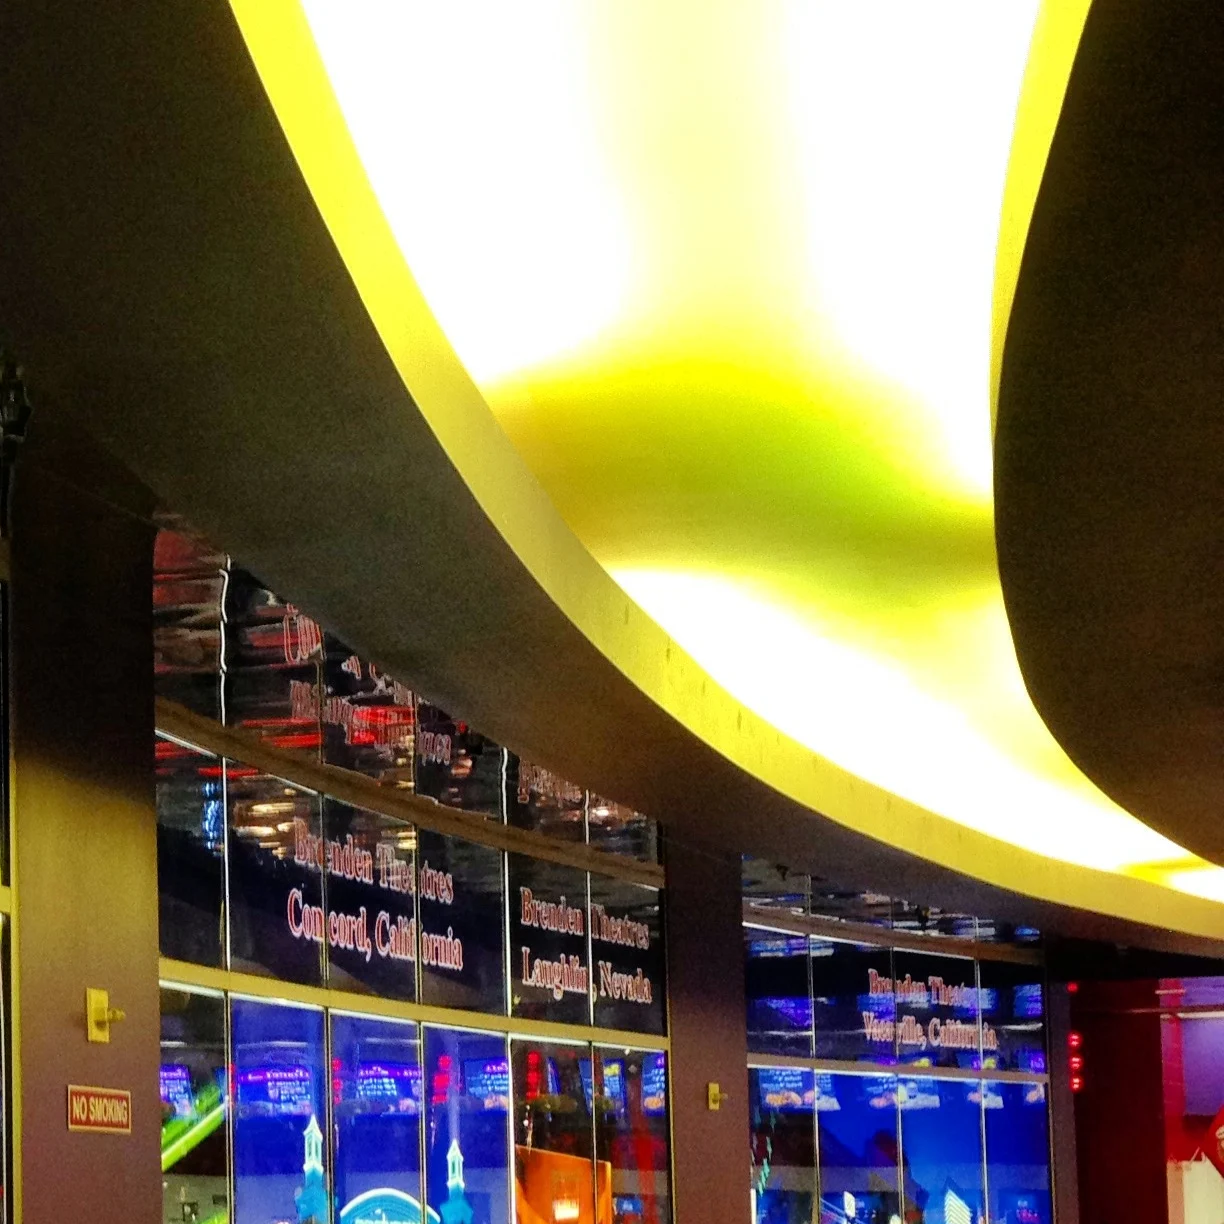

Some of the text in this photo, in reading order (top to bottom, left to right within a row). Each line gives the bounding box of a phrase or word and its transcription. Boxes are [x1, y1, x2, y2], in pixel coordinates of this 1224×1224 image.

[293, 816, 454, 904] Brenden Theatres
[287, 888, 464, 972] Concord, California
[520, 886, 650, 950] Brenden Theatres
[598, 960, 653, 1004] Nevada
[72, 1095, 128, 1126] NO SMOKING
